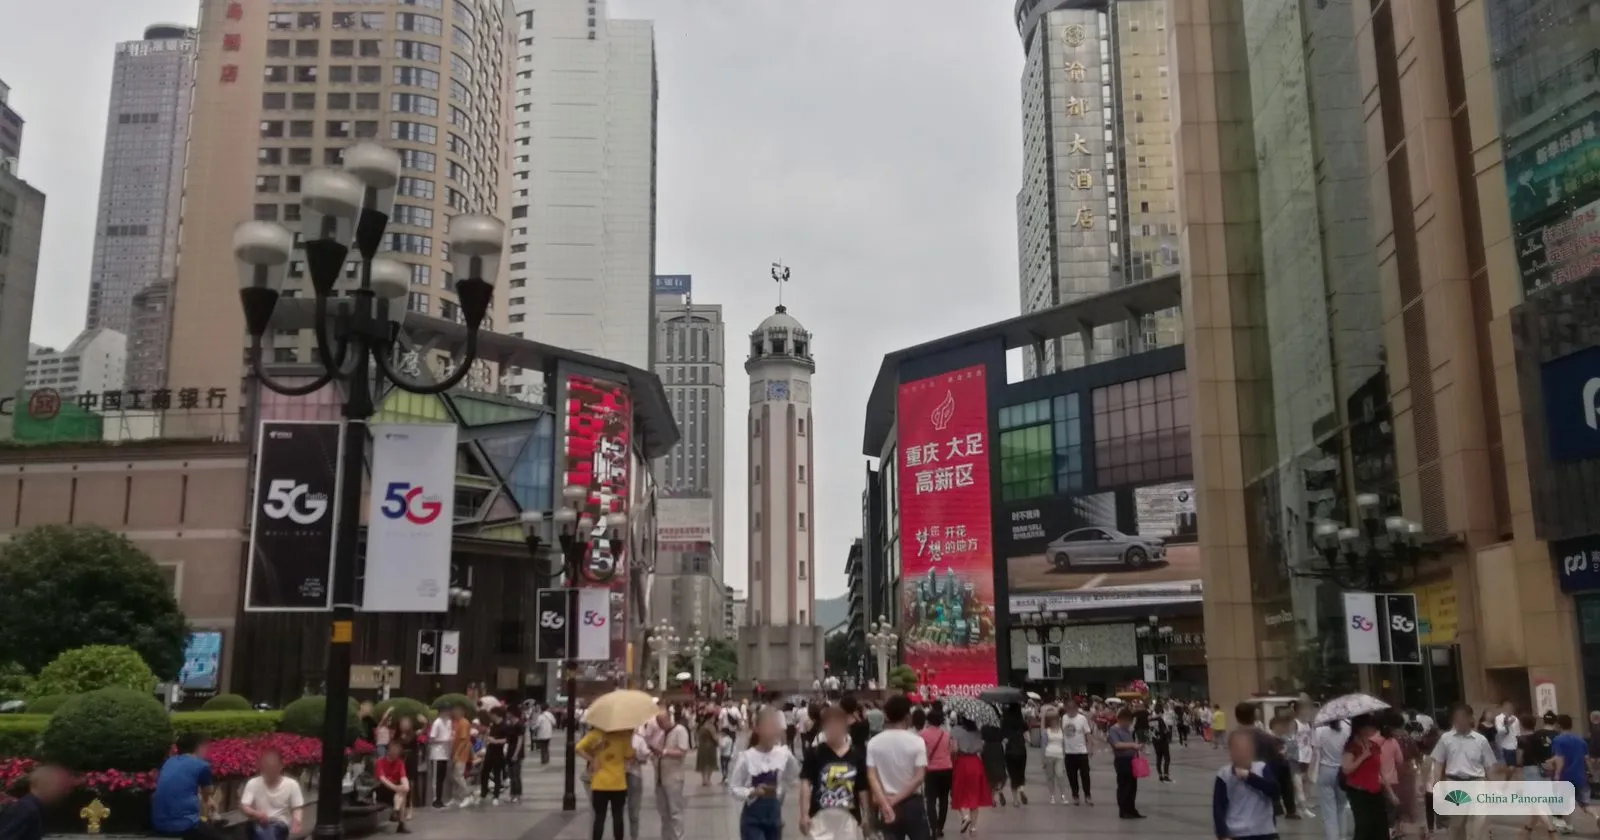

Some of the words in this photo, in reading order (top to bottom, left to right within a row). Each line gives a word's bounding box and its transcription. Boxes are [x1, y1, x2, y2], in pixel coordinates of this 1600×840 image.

[1064, 61, 1094, 230] 渝都大酒店
[78, 387, 228, 413] 中国工商银行
[906, 443, 939, 467] 重庆
[946, 432, 984, 460] 大足
[915, 463, 975, 495] 高新区
[263, 479, 328, 525] 5G
[381, 482, 442, 526] 5G
[540, 610, 566, 629] 5G
[583, 610, 606, 627] 5G
[1351, 615, 1374, 632] 5G
[1392, 615, 1415, 633] 5G
